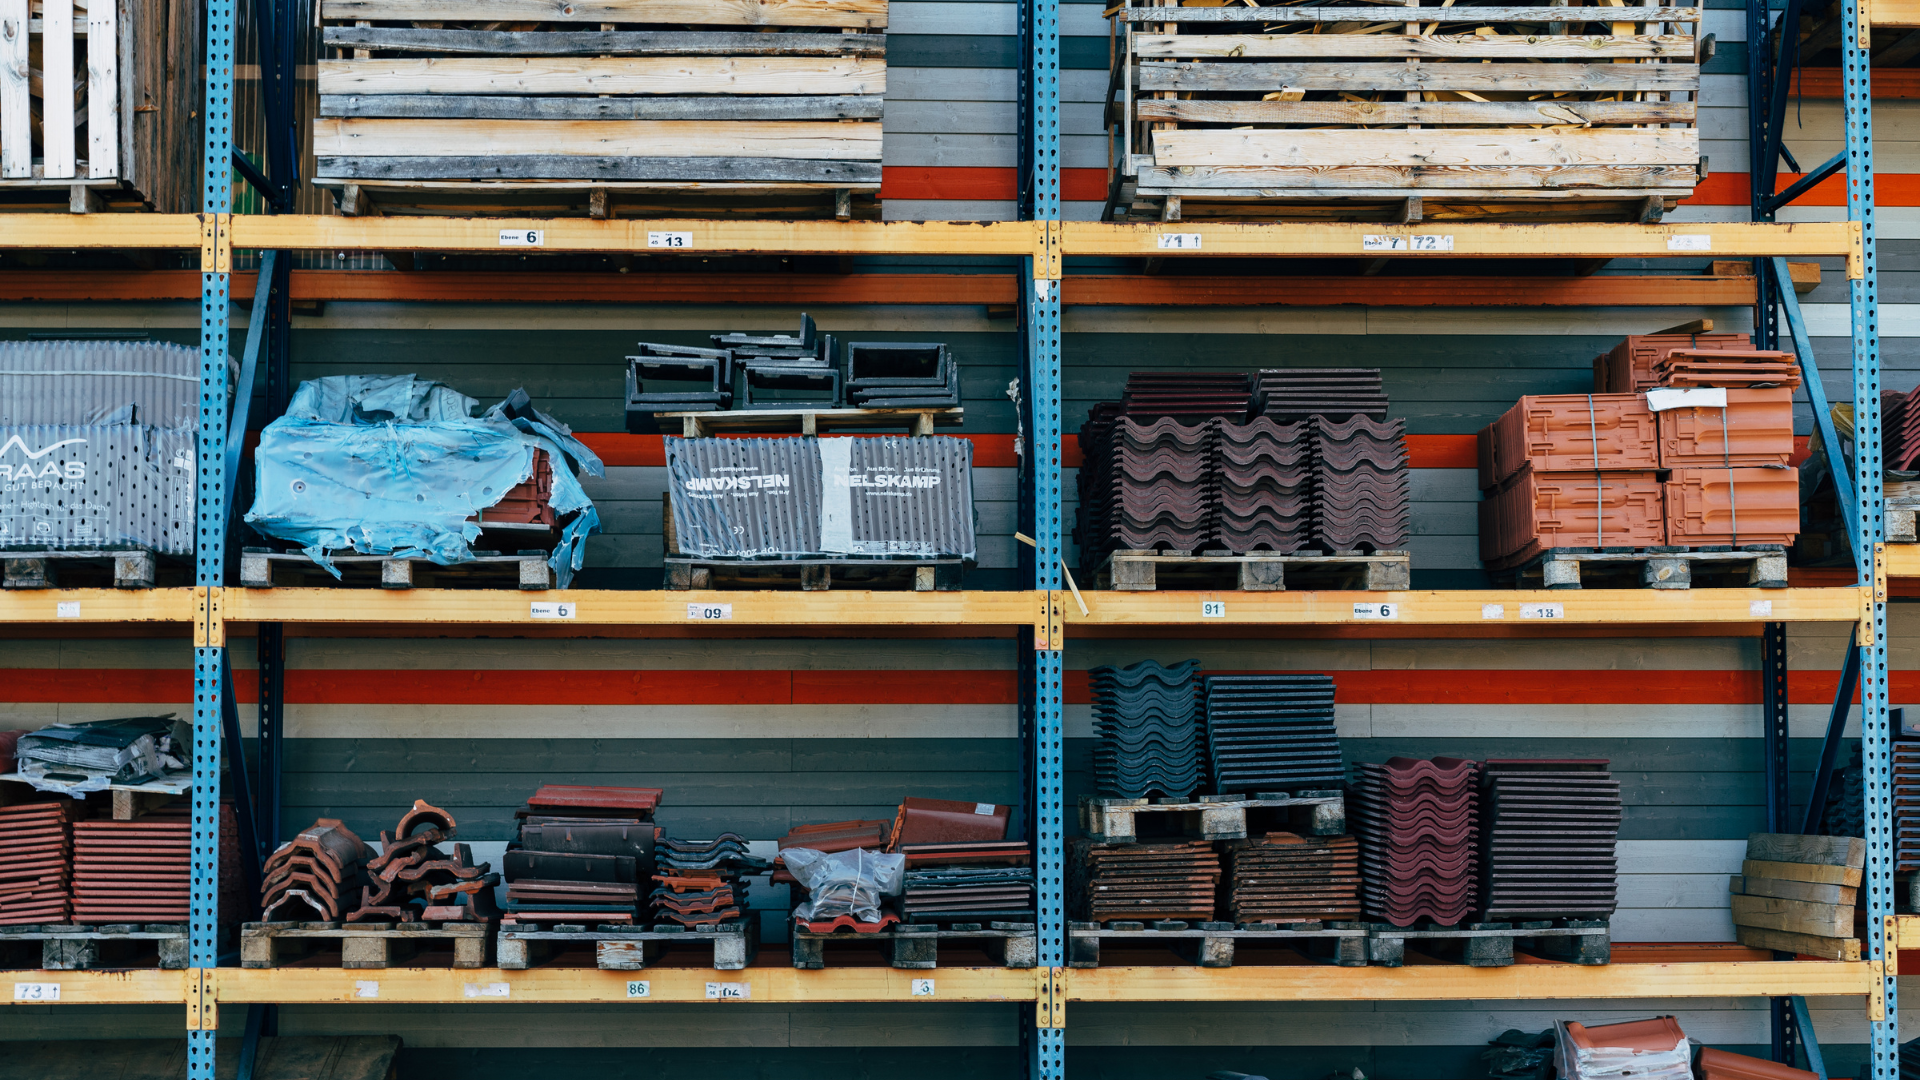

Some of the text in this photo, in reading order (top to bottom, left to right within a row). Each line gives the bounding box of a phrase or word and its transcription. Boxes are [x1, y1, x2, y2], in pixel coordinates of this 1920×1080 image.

[526, 231, 536, 243] 6
[666, 236, 683, 246] 13
[1164, 234, 1182, 248] 71
[1392, 237, 1400, 248] 7
[1414, 236, 1436, 249] 72
[0, 461, 86, 481] RAAS
[4, 480, 84, 492] GUT BEDACHT
[686, 474, 790, 491] NELSKAMP
[834, 474, 941, 488] NELSKAMP
[20, 500, 54, 510] Hightech
[70, 502, 82, 510] das
[86, 501, 108, 512] Dach.
[558, 604, 568, 616] 6
[704, 608, 722, 618] 09
[1205, 604, 1218, 614] 91
[1380, 604, 1390, 616] 6
[20, 984, 42, 998] 73
[630, 984, 644, 994] 86
